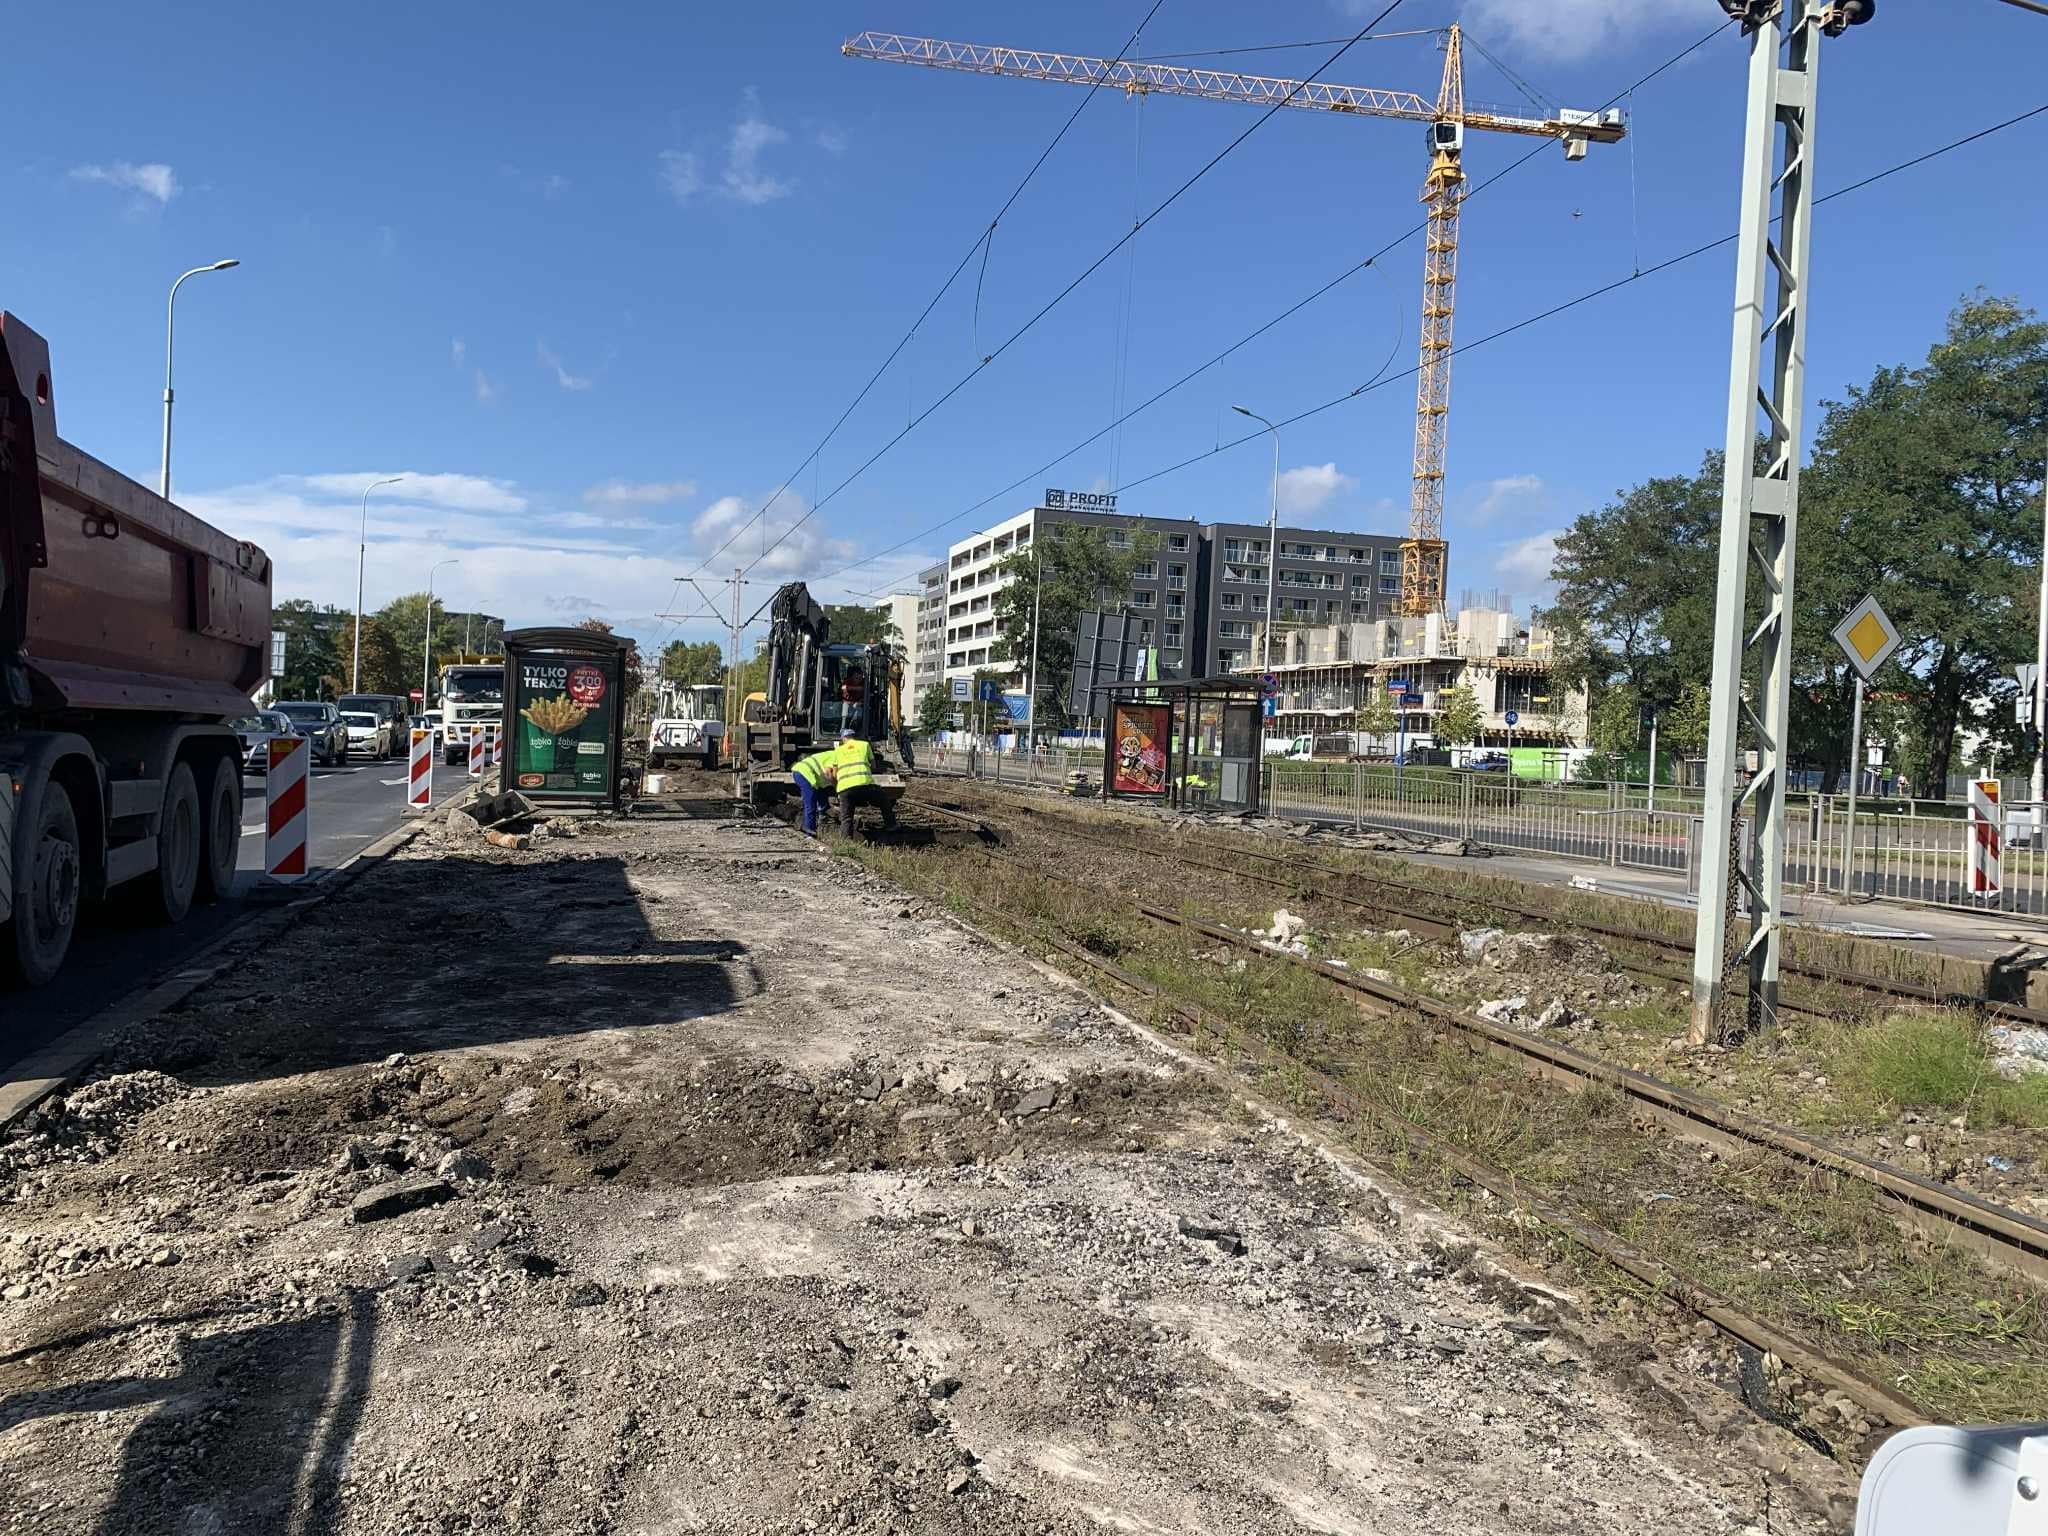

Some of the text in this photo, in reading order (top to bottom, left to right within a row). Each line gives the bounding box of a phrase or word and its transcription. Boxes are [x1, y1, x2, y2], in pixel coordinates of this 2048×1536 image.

[1070, 492, 1118, 507] PROFIT
[523, 666, 567, 677] TYLKO
[523, 677, 566, 689] TERAZ
